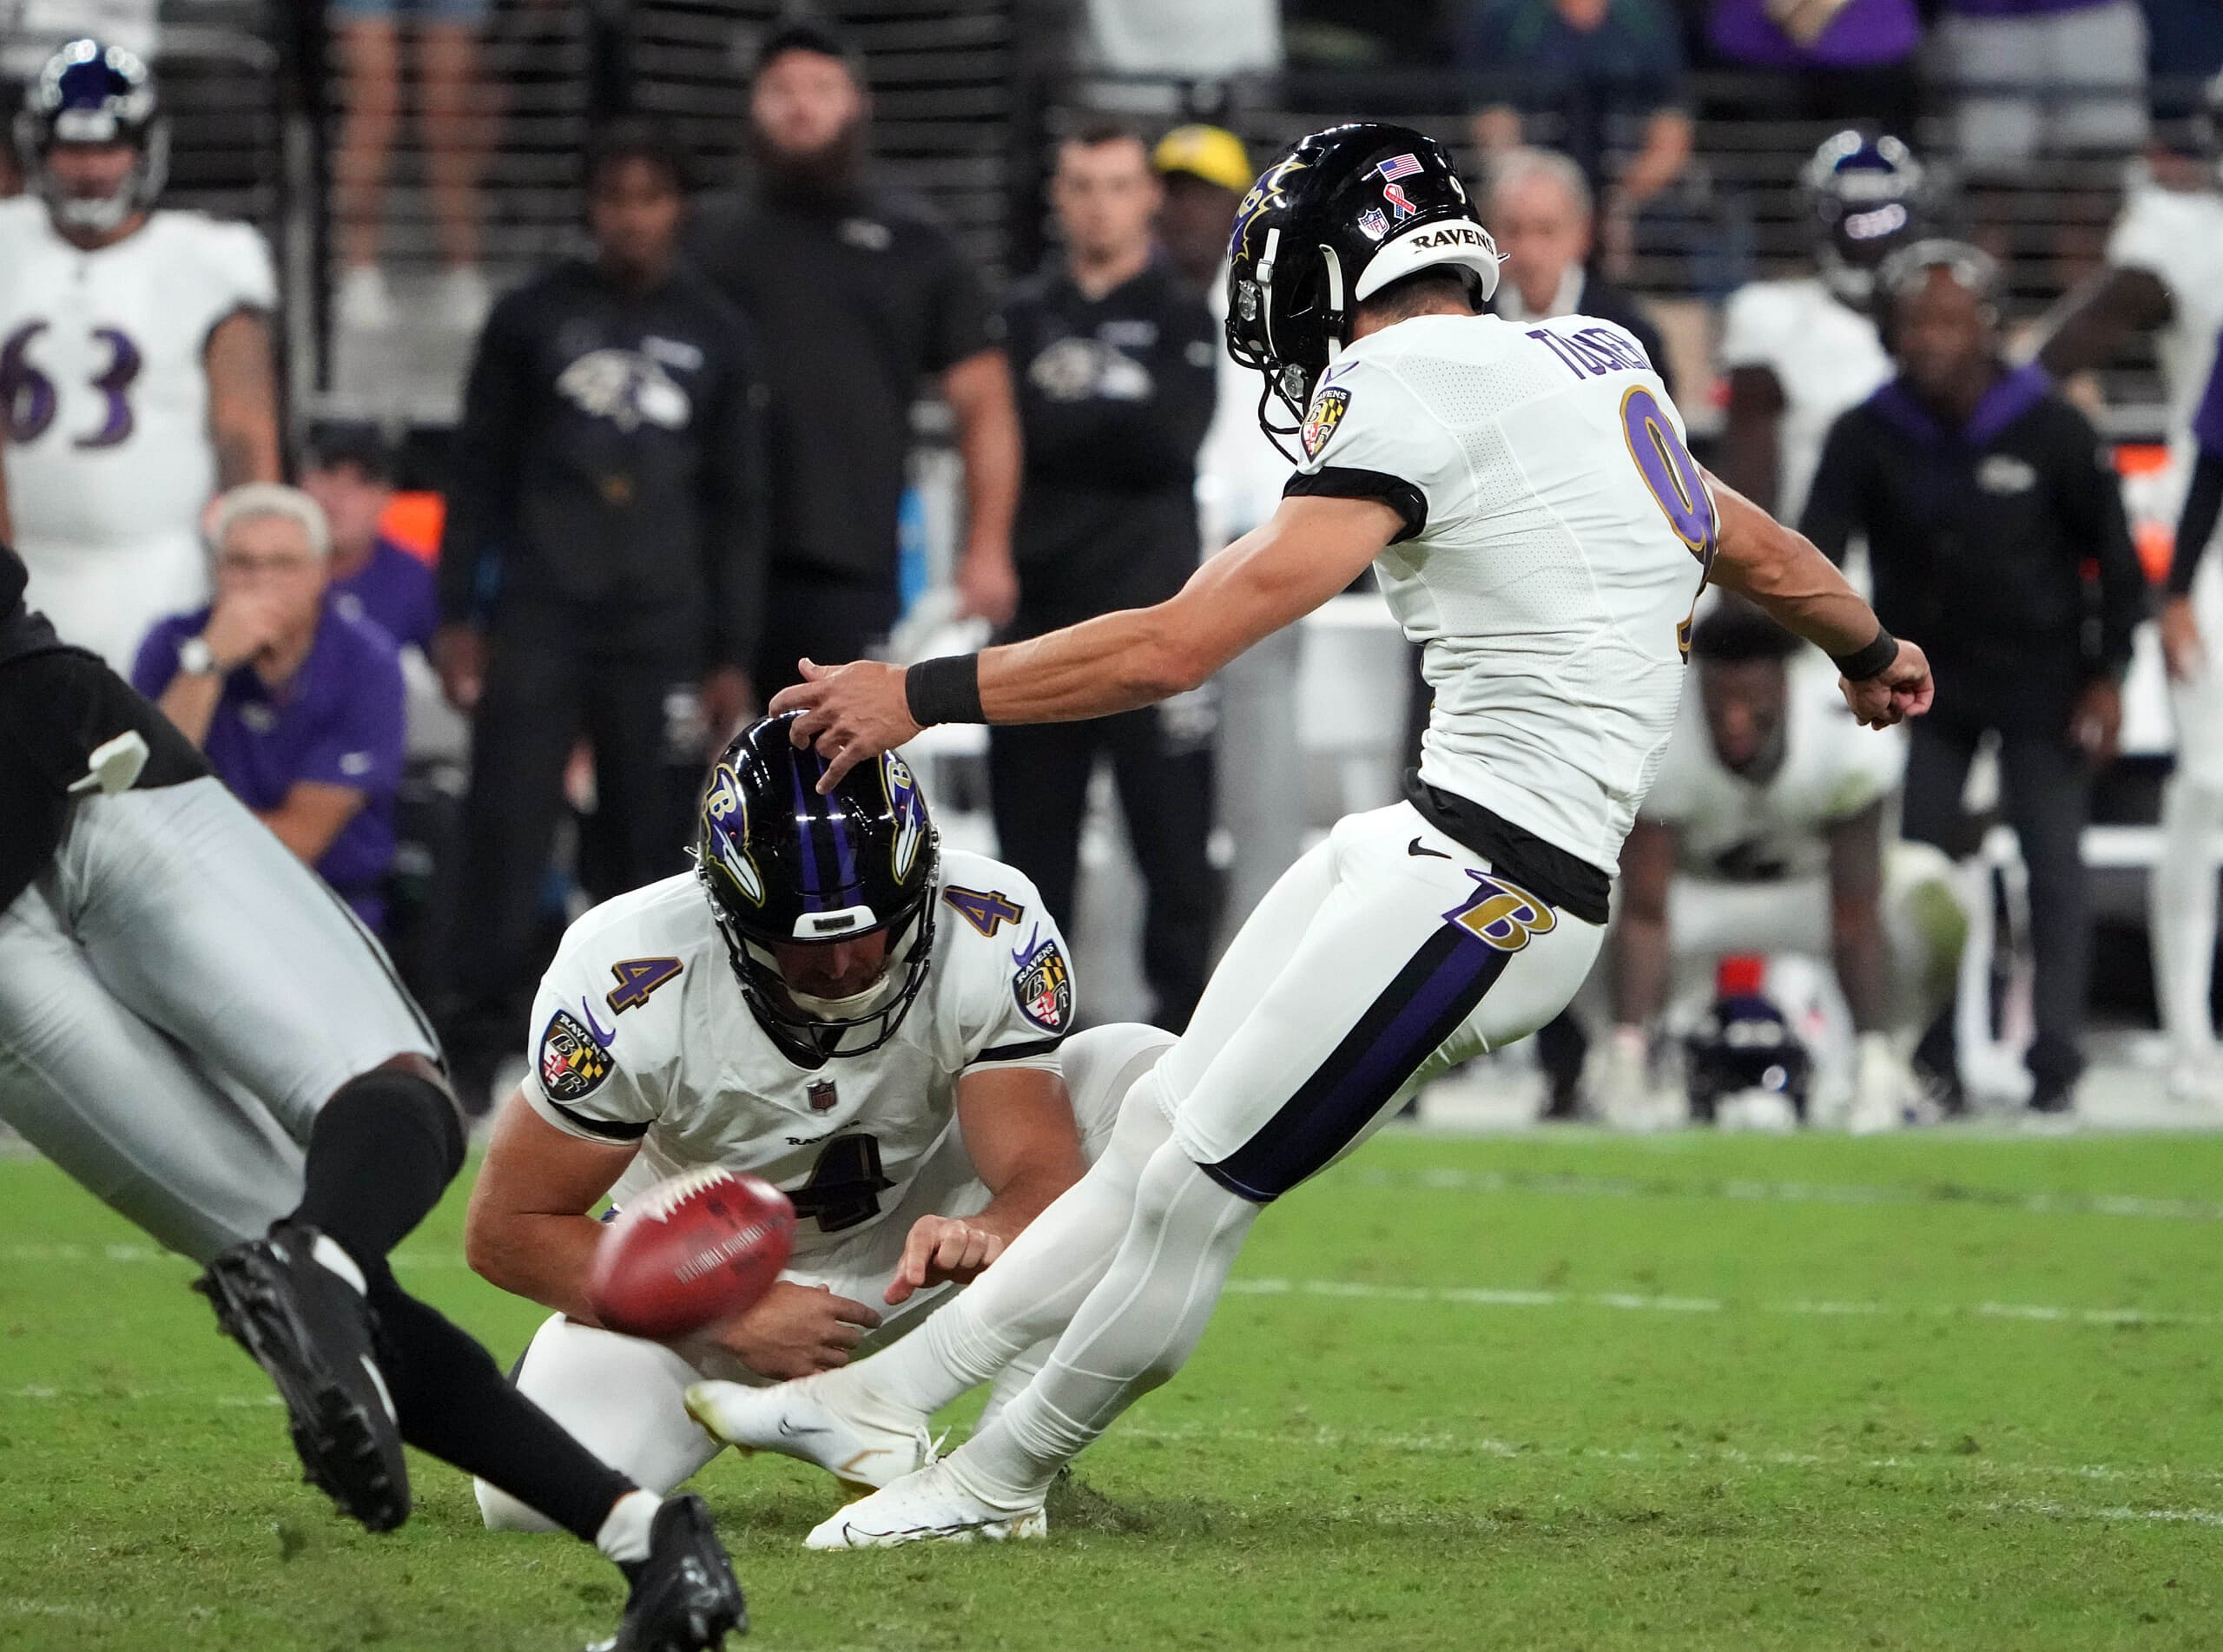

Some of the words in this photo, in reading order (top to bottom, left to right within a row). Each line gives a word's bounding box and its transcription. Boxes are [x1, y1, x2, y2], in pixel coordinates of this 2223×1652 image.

[0, 319, 142, 451] 63
[941, 885, 1025, 938] 4
[1452, 869, 1557, 952] B
[605, 956, 683, 1016] 4
[1016, 942, 1055, 984] RAVENS
[783, 1133, 898, 1233] 4
